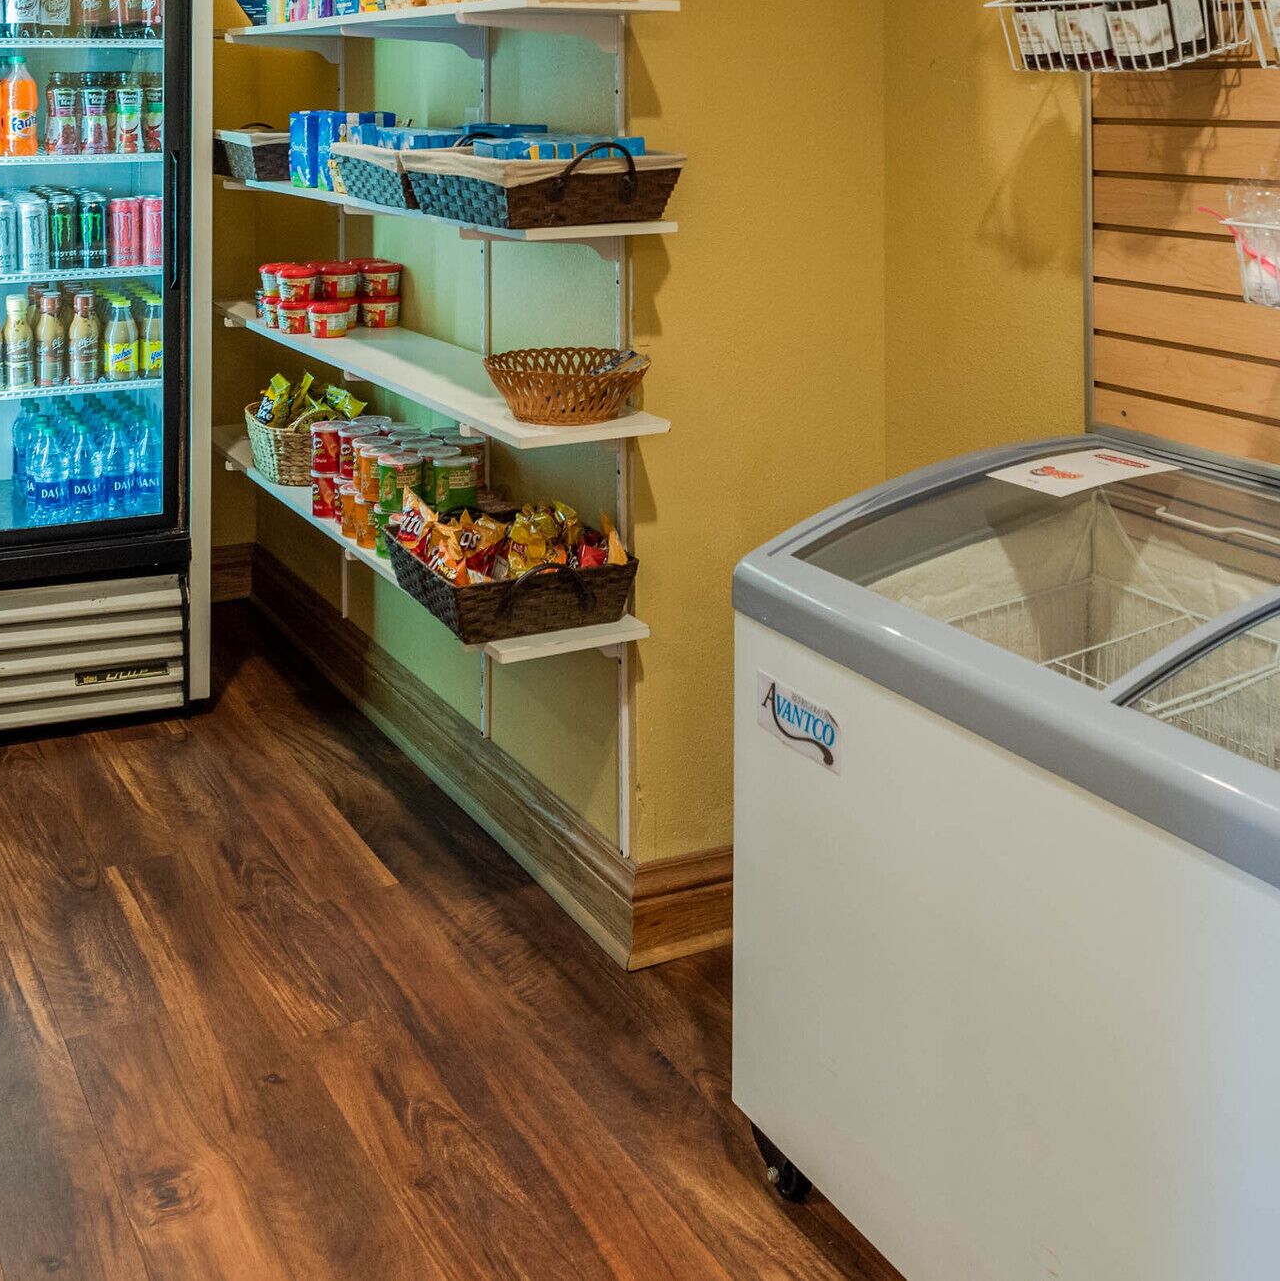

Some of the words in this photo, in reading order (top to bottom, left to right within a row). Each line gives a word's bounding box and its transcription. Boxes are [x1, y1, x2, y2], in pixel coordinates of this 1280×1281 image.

[41, 487, 65, 499] DASA
[74, 482, 97, 495] DASA
[761, 682, 835, 747] AVANTCO
